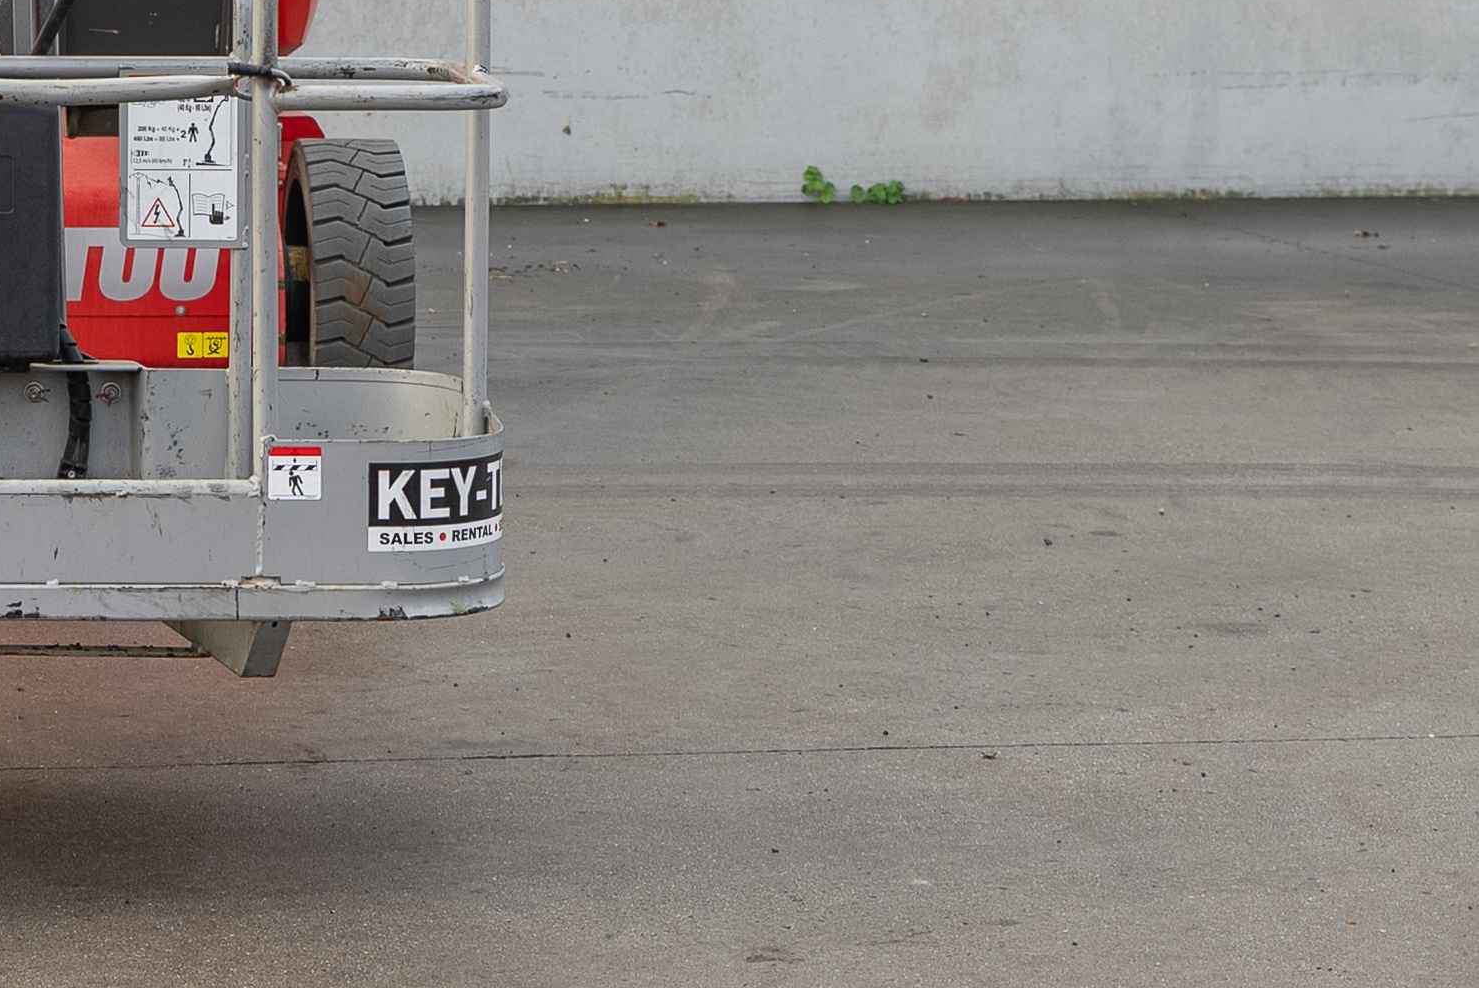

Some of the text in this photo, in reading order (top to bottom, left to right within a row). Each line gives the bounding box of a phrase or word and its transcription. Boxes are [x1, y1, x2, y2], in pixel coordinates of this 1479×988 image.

[180, 130, 187, 139] 2
[378, 458, 502, 520] KEY-T
[379, 532, 434, 545] SALES
[452, 524, 492, 542] RENTAL
